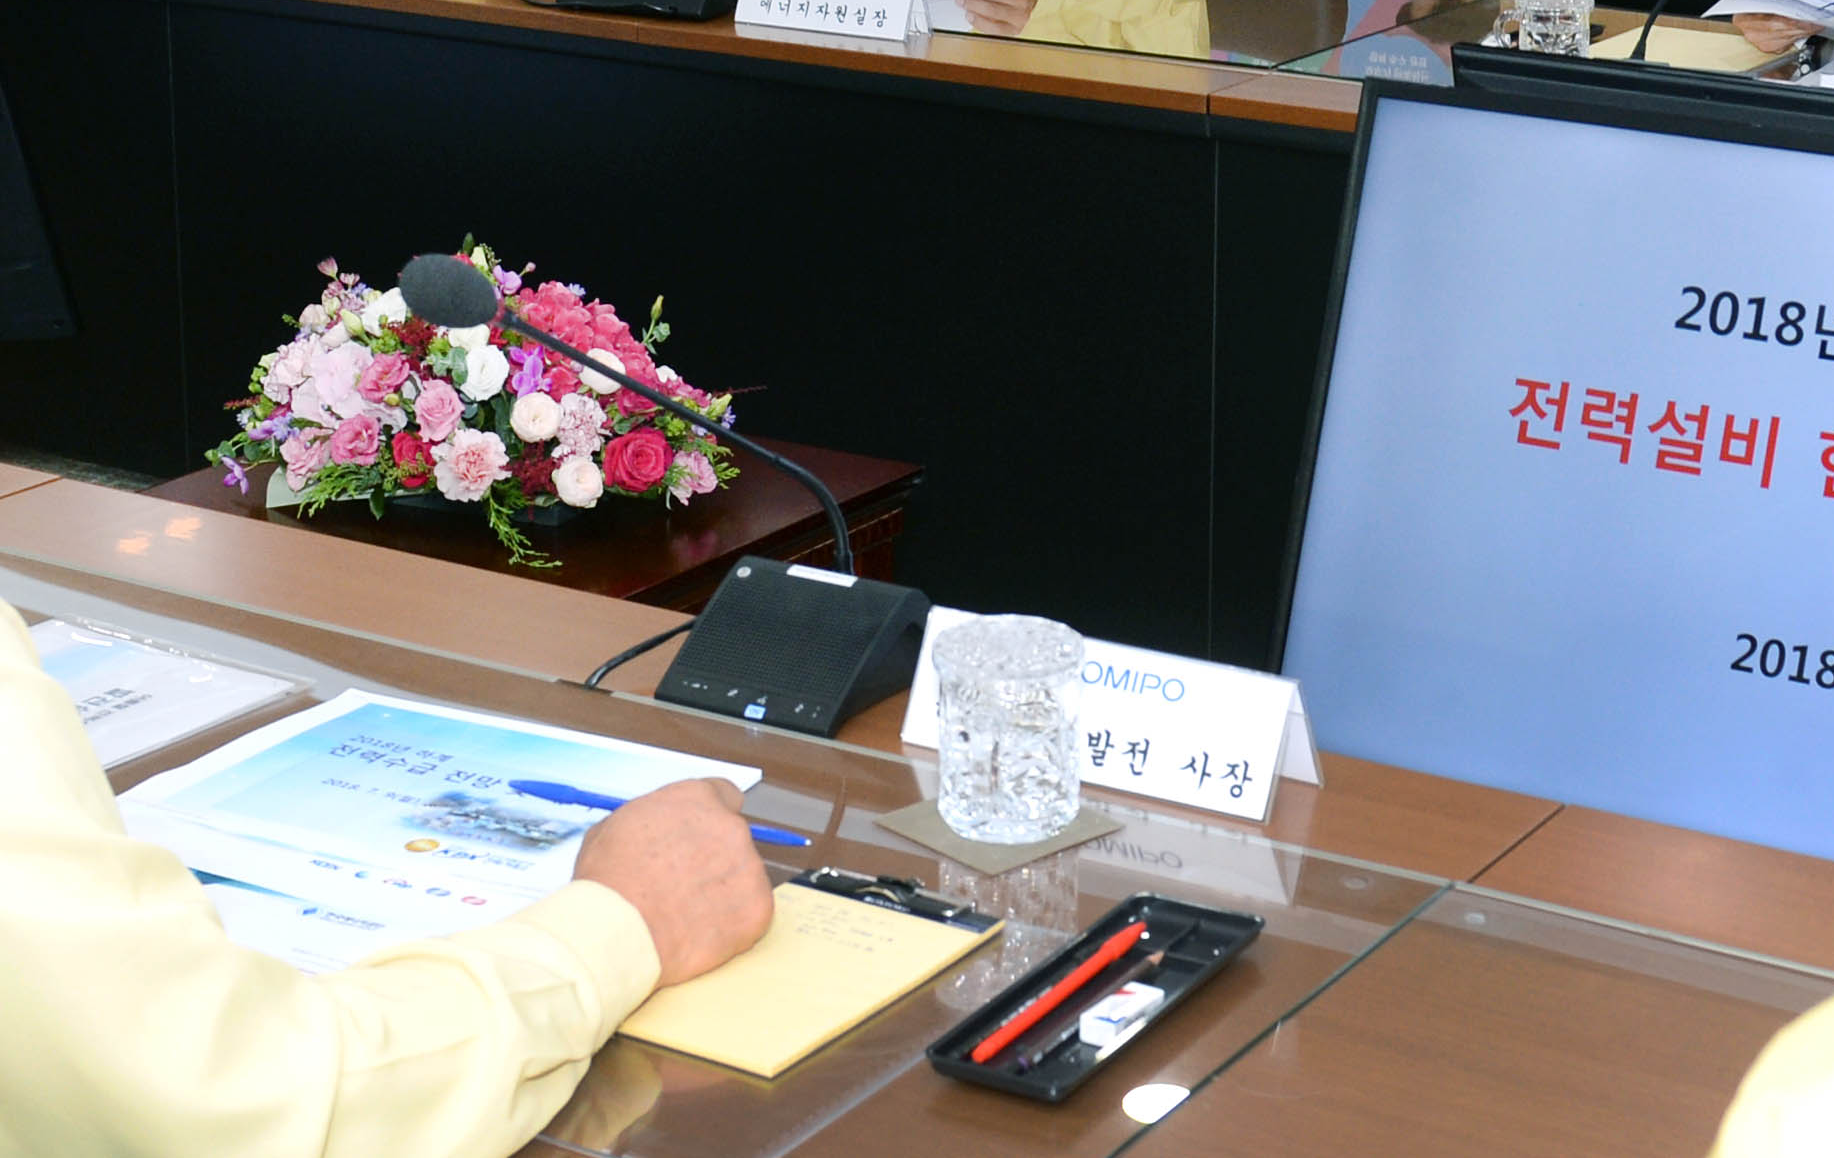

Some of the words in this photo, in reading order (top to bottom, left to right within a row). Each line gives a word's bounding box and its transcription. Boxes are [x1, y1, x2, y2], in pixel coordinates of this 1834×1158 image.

[1507, 375, 1783, 491] 전력설비
[1079, 660, 1186, 702] OMIPO
[329, 743, 438, 776] 전력수급
[444, 769, 503, 790] 전망
[1178, 752, 1254, 800] 사장
